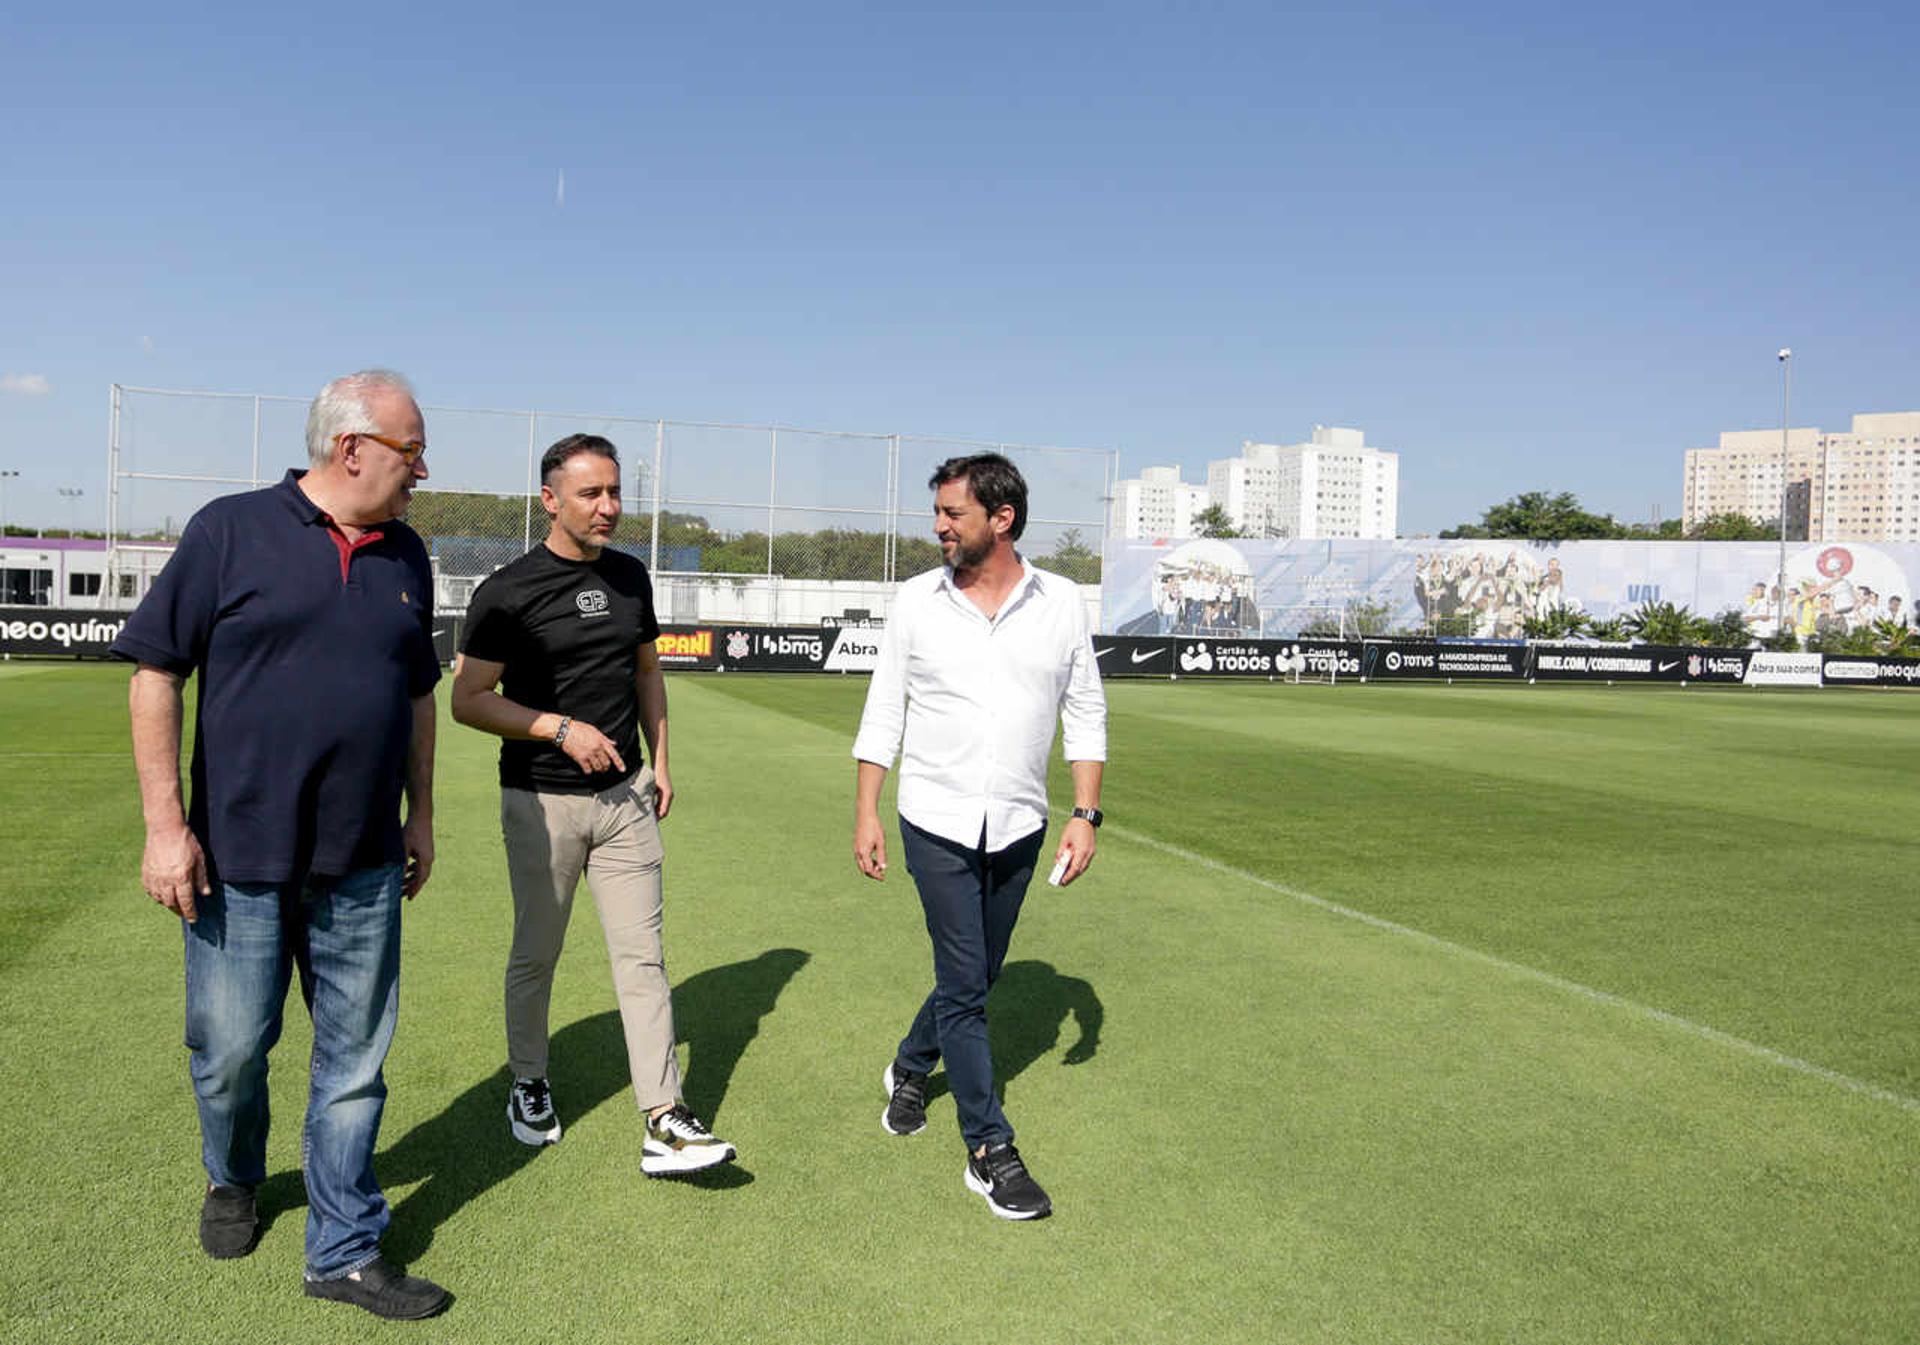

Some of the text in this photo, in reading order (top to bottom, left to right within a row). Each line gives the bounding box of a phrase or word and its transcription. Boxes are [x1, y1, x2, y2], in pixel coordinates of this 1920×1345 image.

[778, 635, 822, 661] bmg
[838, 642, 879, 656] Abra
[1216, 656, 1271, 671] TODOS
[1308, 658, 1360, 673] TODOS
[1403, 655, 1434, 667] TOTVS
[1717, 658, 1743, 678] bmg
[1752, 663, 1820, 674] Abra sua conta
[1880, 664, 1902, 677] neo
